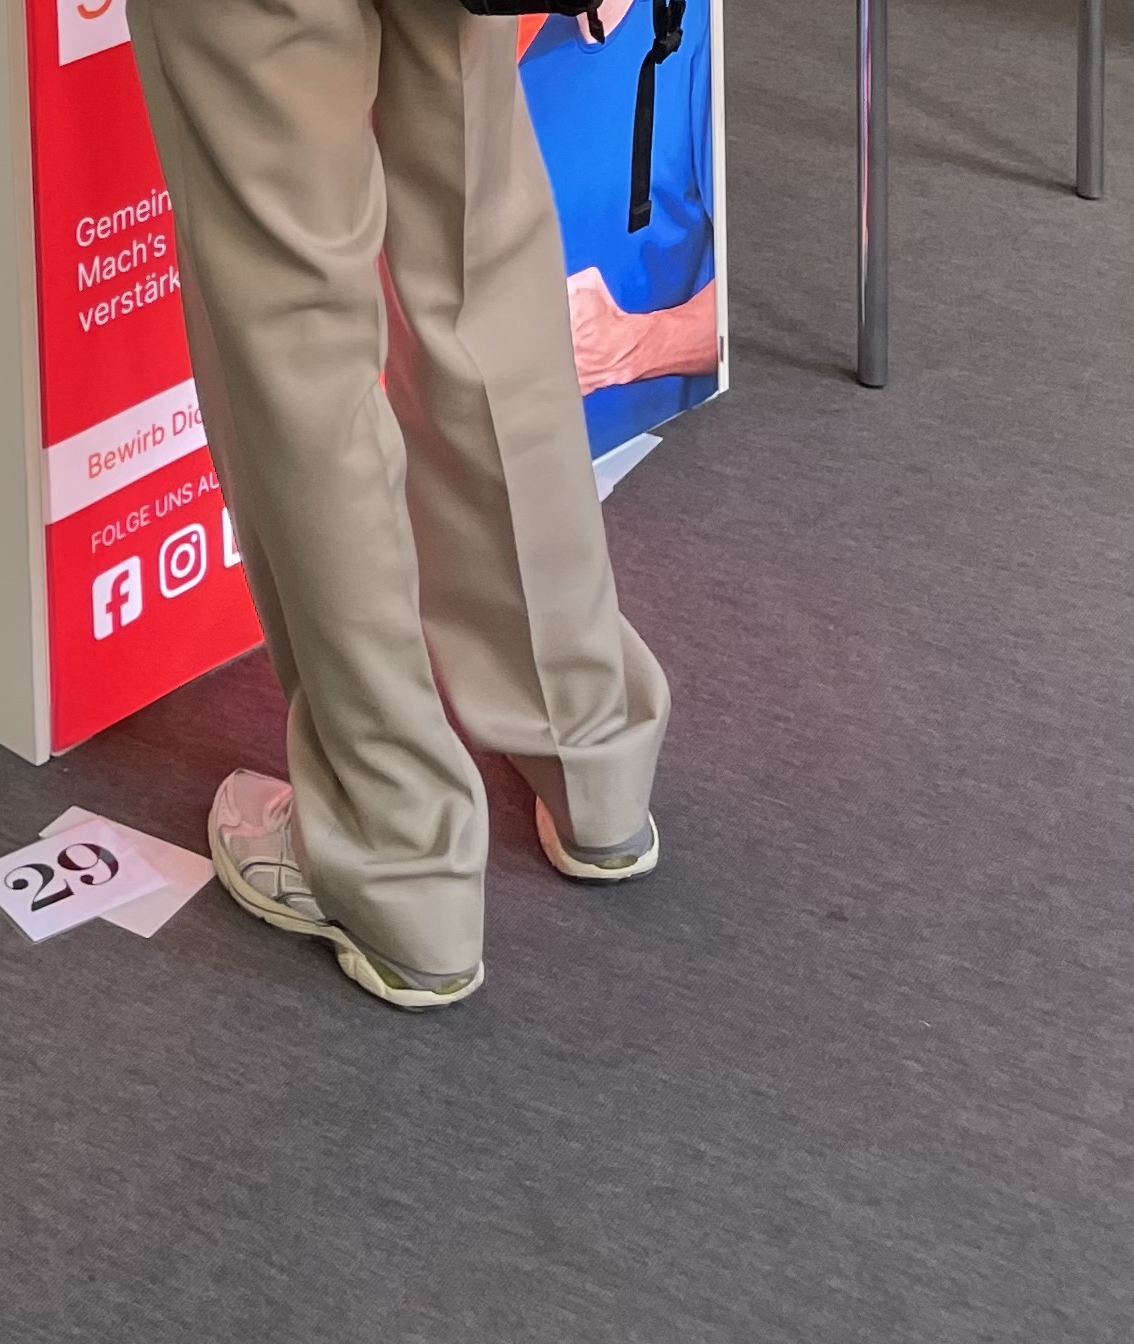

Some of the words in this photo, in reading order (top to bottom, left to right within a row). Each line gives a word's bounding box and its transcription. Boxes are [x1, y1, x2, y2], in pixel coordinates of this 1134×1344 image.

[76, 188, 172, 247] Gemein
[78, 265, 181, 333] verstärk
[88, 423, 165, 480] Bewirb
[91, 504, 150, 554] FOLGE
[155, 483, 193, 518] UNS
[4, 842, 119, 912] 29
